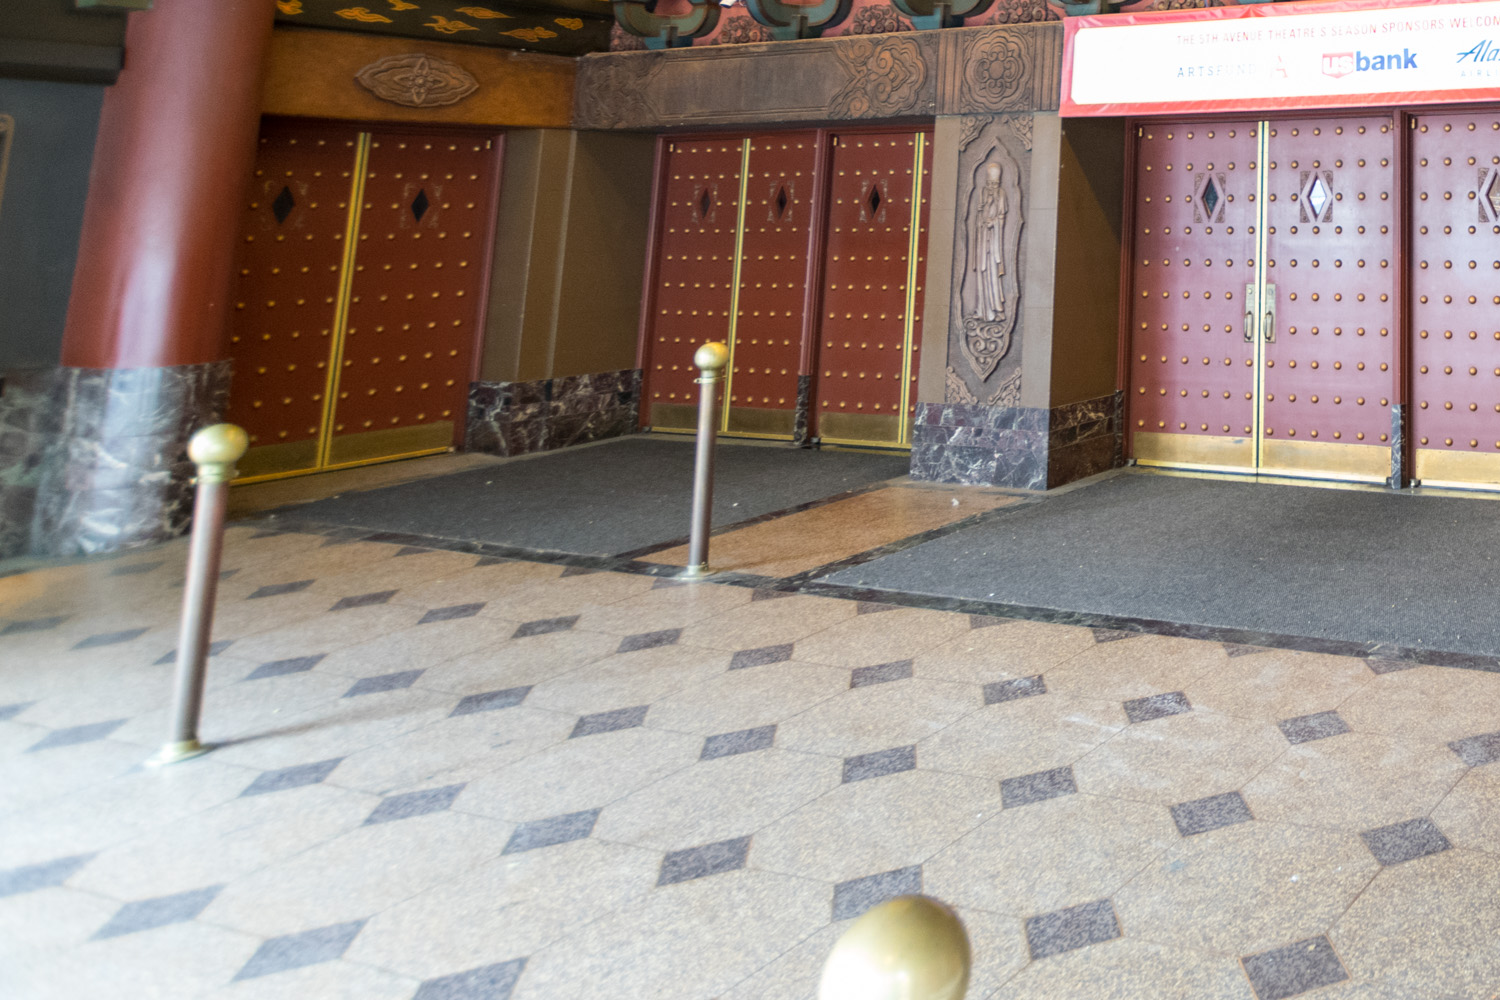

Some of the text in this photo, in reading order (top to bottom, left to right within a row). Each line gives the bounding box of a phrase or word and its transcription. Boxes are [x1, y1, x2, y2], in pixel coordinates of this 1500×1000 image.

[1177, 35, 1195, 45] THE
[1200, 33, 1218, 44] 5TH
[1223, 30, 1262, 43] AVENUE
[1269, 26, 1327, 41] THEATRES
[1331, 23, 1377, 37] SEASON
[1382, 18, 1445, 33] SPONSORS
